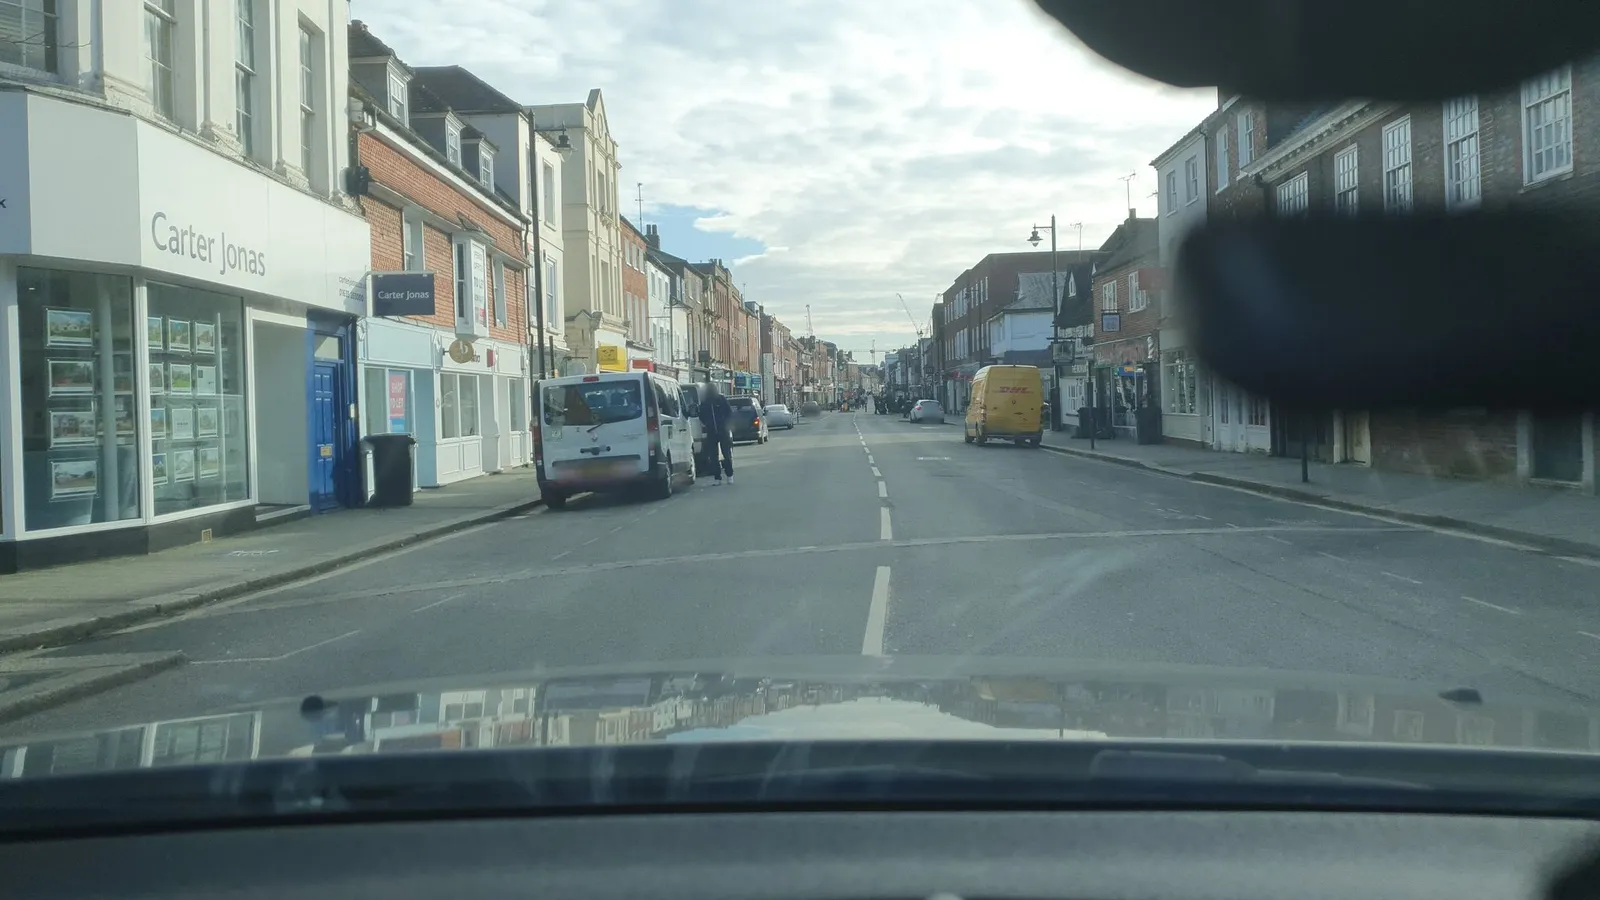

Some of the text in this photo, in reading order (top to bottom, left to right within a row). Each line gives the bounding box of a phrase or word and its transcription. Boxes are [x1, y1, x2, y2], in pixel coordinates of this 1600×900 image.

[151, 211, 265, 277] Carter Jonas
[378, 291, 429, 300] Carter Jonas
[999, 386, 1029, 394] DHL
